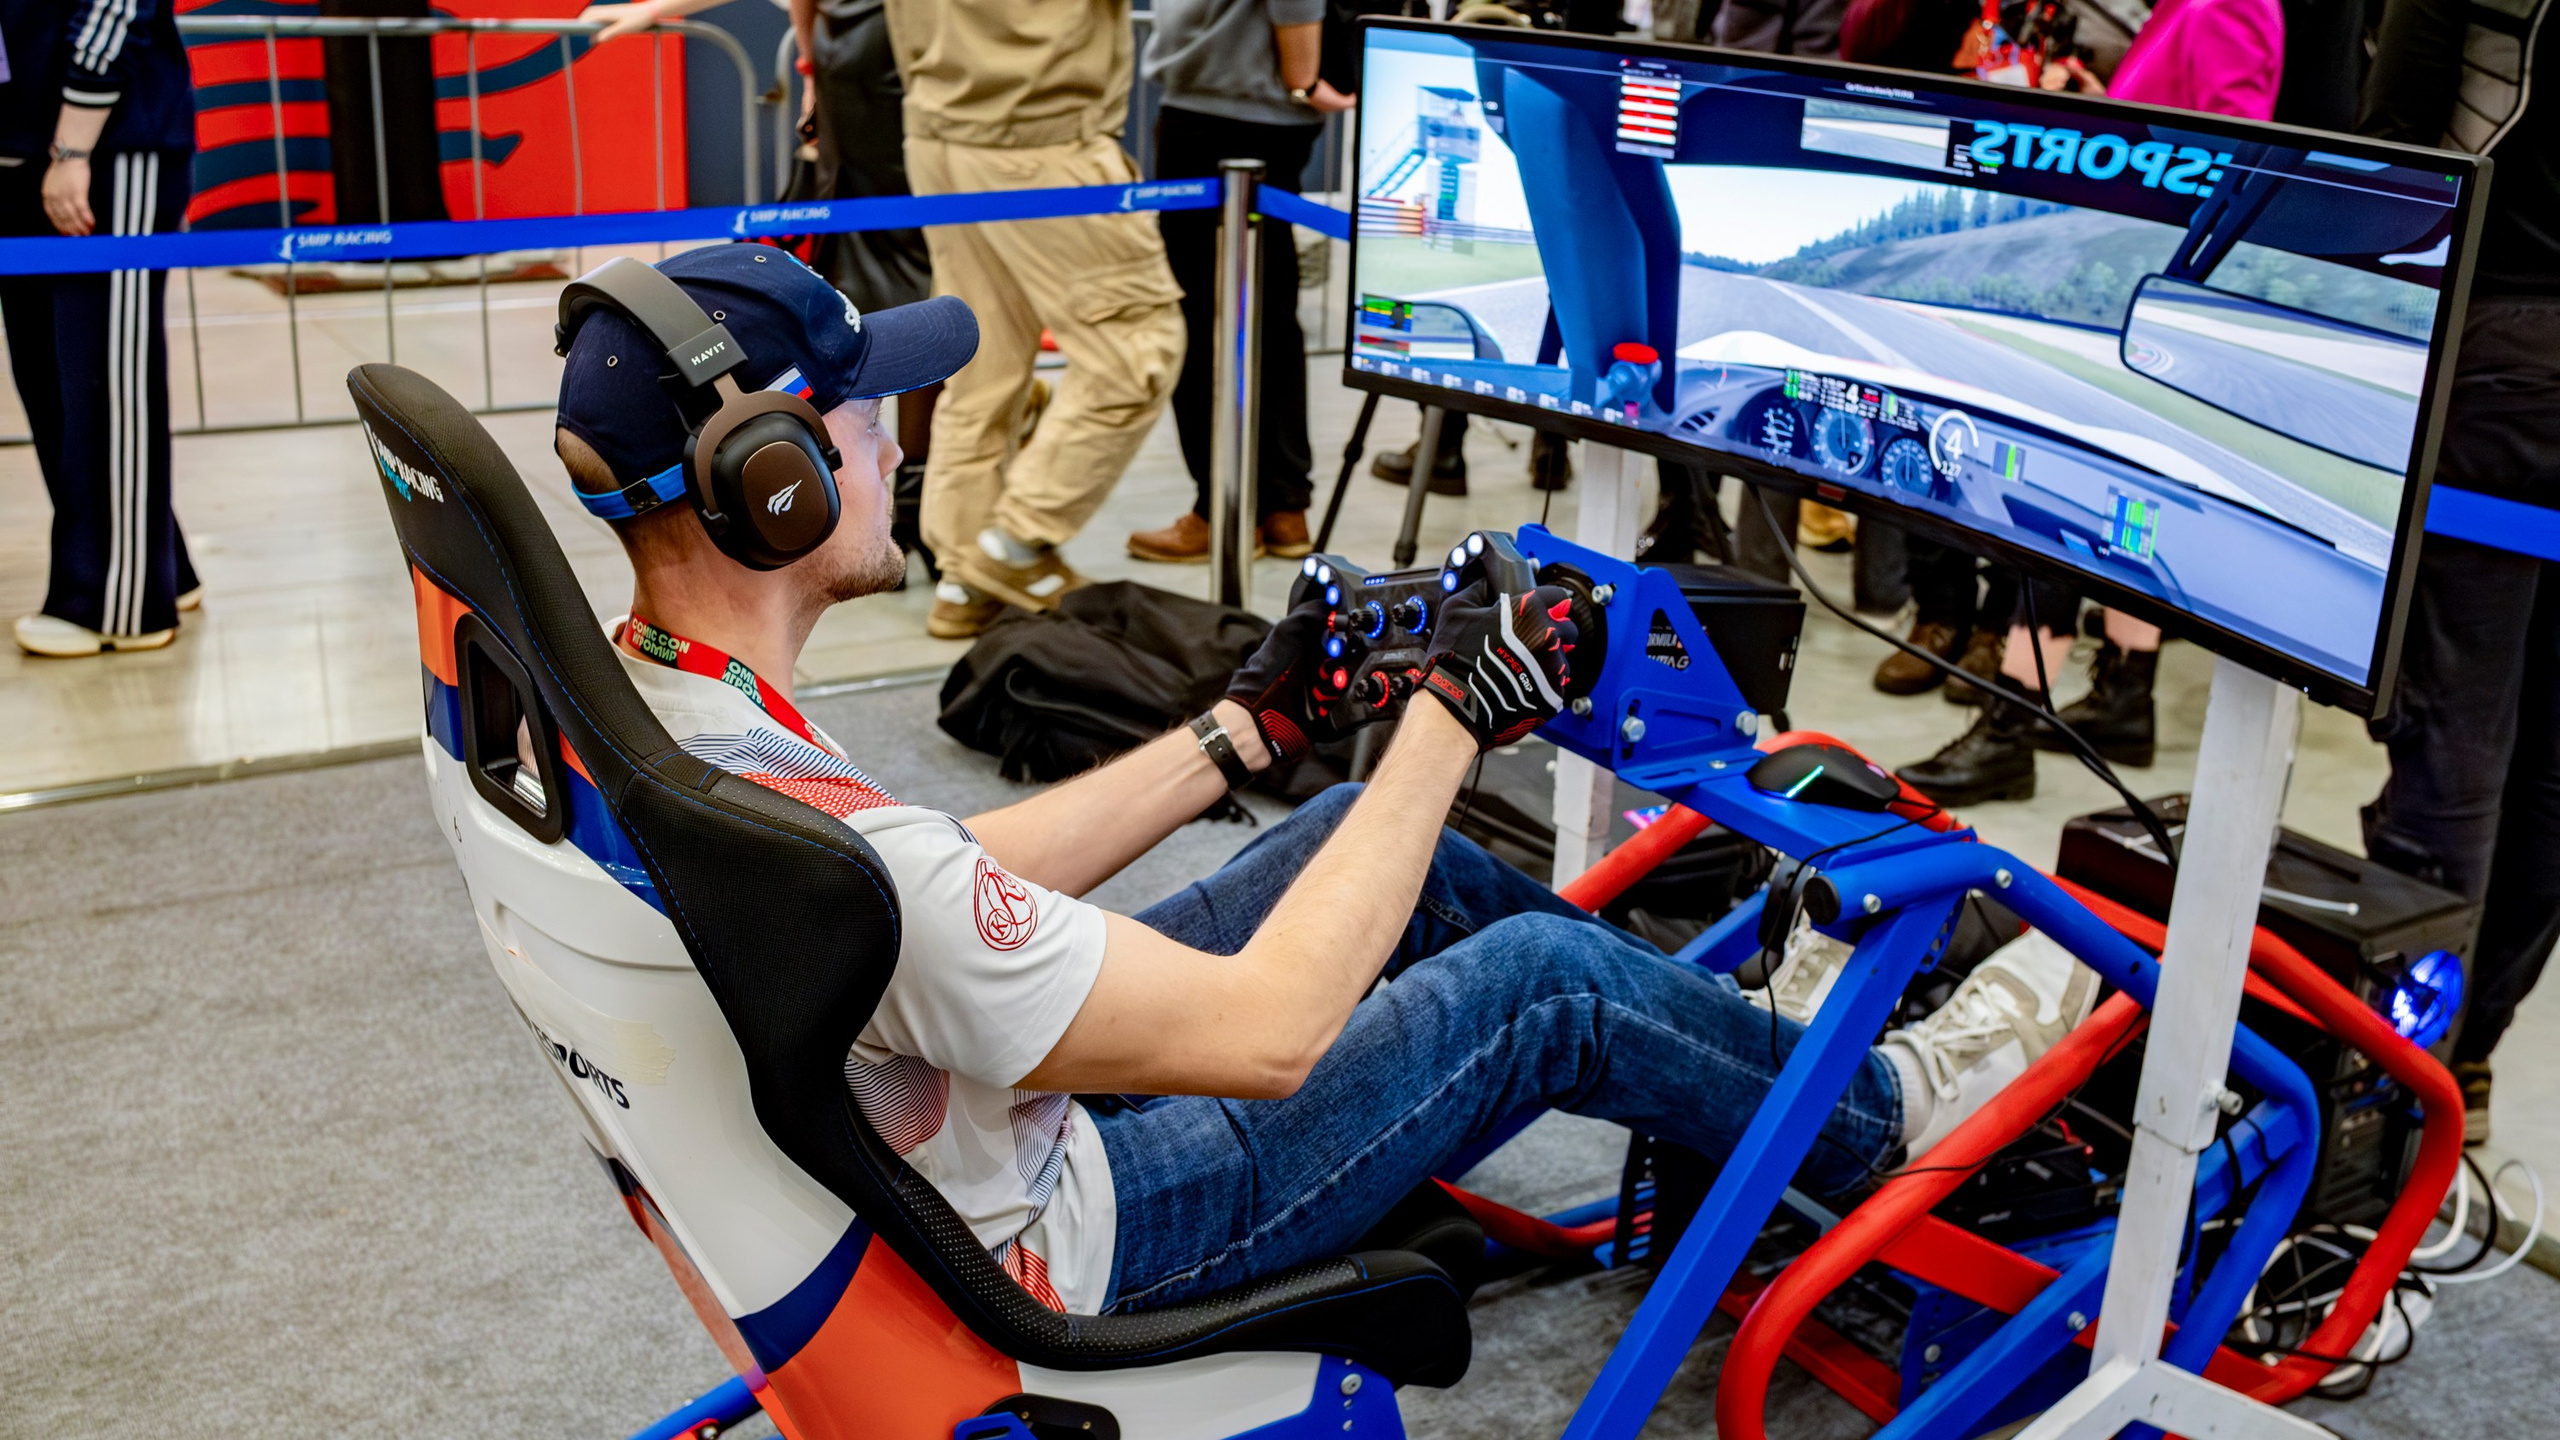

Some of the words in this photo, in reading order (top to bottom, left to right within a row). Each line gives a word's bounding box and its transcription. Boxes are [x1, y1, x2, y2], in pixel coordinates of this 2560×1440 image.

[691, 341, 726, 366] HAVIT
[1944, 428, 1963, 460] 4
[395, 456, 444, 503] RACING
[632, 618, 658, 642] COMIC
[658, 633, 690, 654] CON
[1496, 646, 1523, 675] HYPER
[1518, 672, 1534, 693] GRIP
